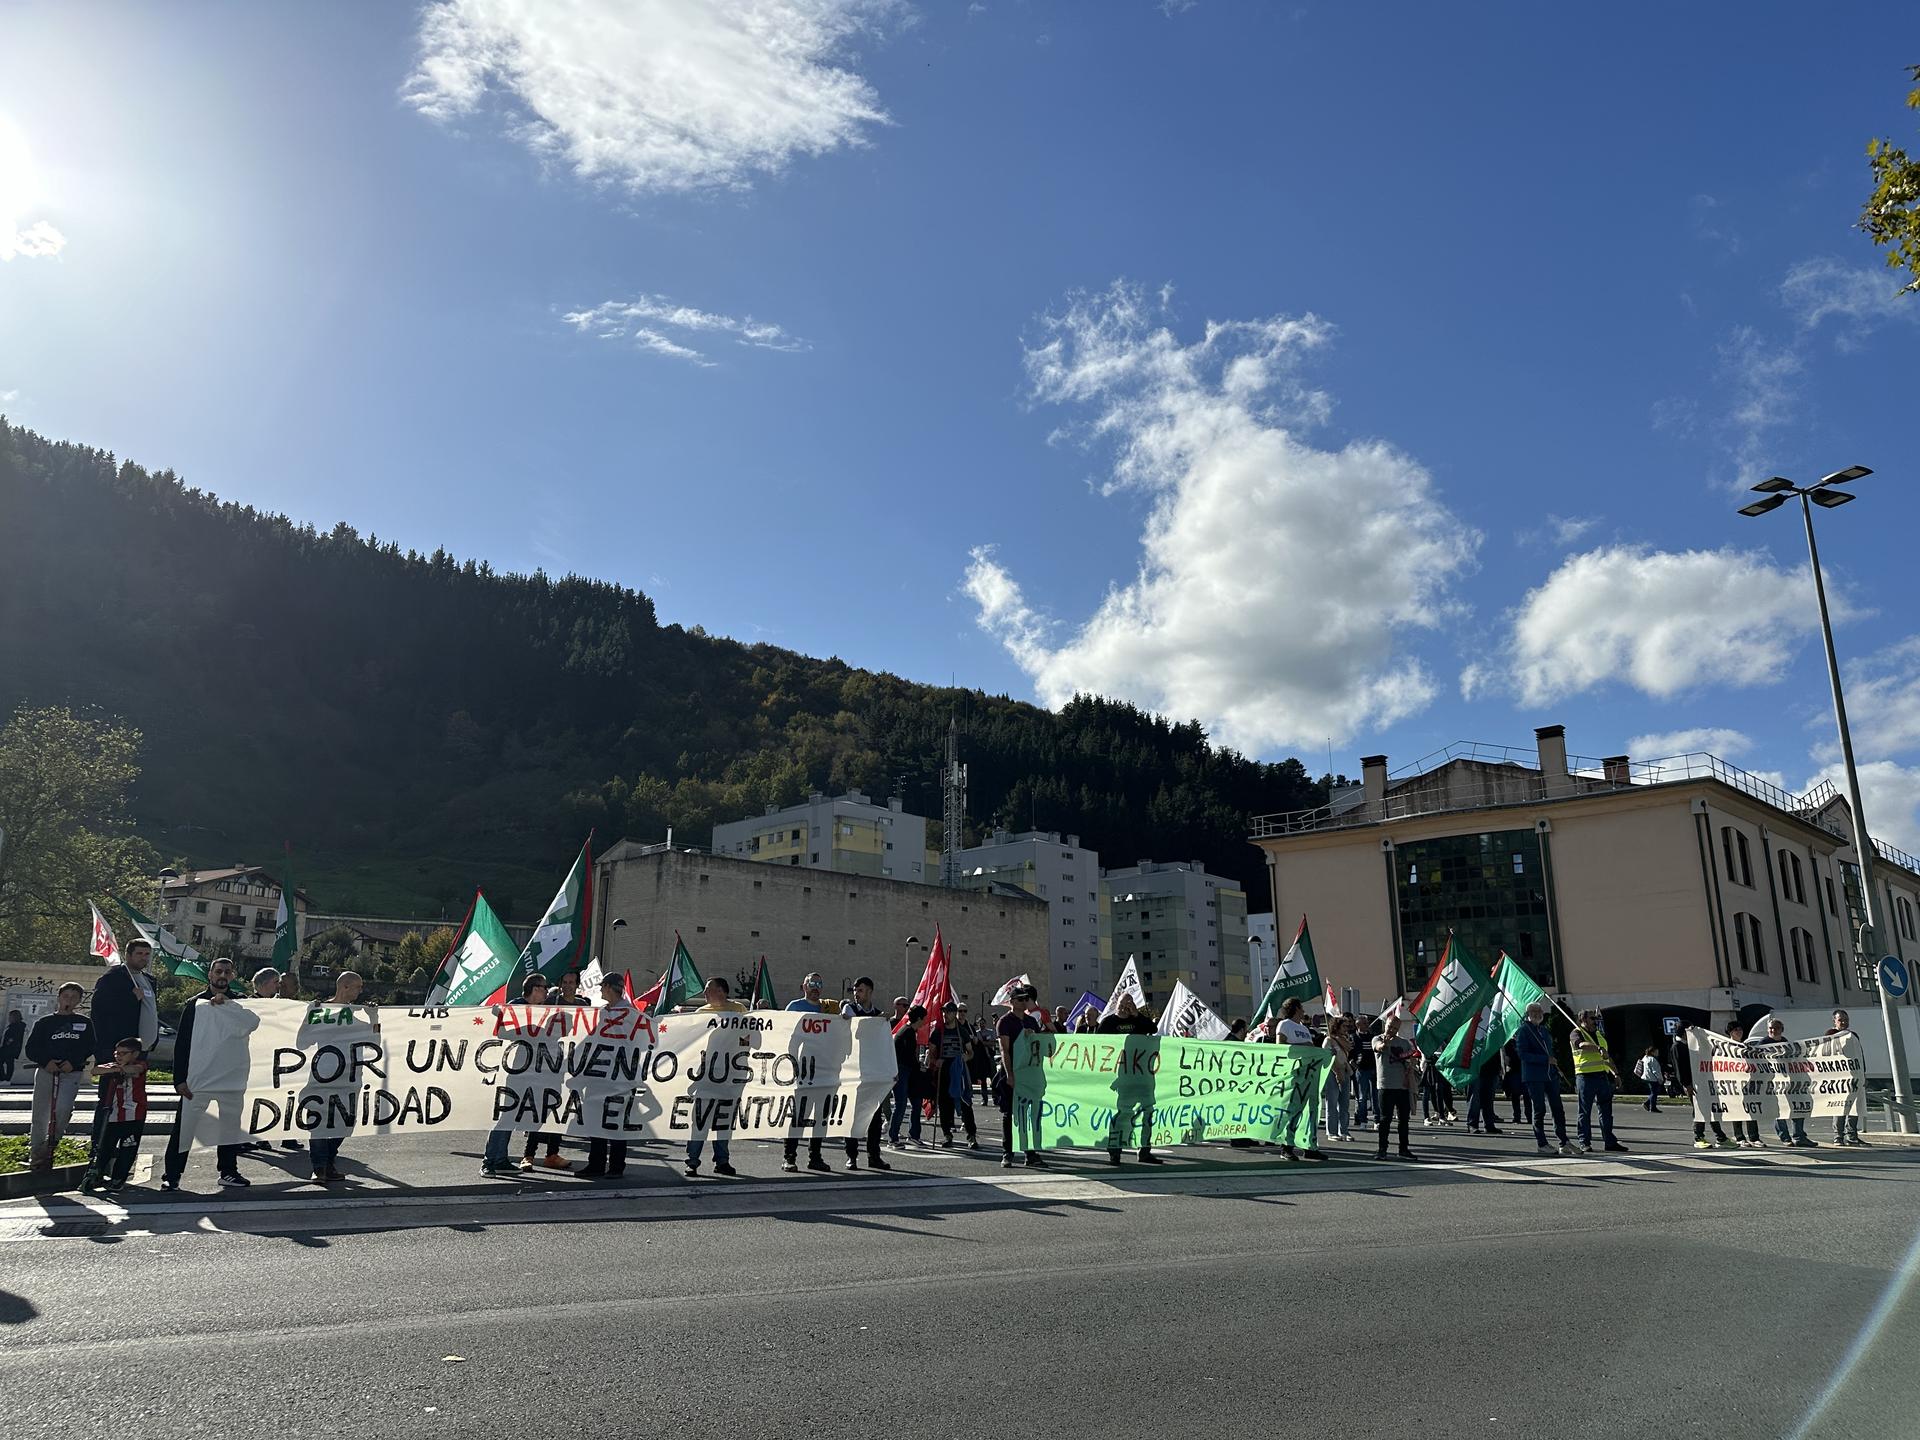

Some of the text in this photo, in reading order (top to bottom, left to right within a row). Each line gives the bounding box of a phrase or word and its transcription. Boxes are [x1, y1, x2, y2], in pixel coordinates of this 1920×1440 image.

[308, 1007, 450, 1025] ELA LAB
[492, 1005, 656, 1043] AVANZA
[706, 1017, 831, 1034] AURRERA UGT
[1665, 1020, 1676, 1033] P
[51, 1031, 80, 1040] adidas
[272, 1041, 387, 1088] POR
[405, 1039, 468, 1073] UN
[1028, 1040, 1324, 1080] AVANZAKO LANGILEAK
[1815, 1058, 1861, 1073] BAKARRA
[1708, 1079, 1740, 1096] BESTE
[1741, 1080, 1764, 1096] BAT
[1819, 1079, 1860, 1095] BAIZIK
[493, 1086, 585, 1126] PARA
[602, 1089, 643, 1132] EL
[1711, 1102, 1729, 1113] ELA
[1743, 1101, 1762, 1114] UGT
[1792, 1101, 1811, 1111] LAB
[1090, 1106, 1121, 1131] UN
[1131, 1103, 1225, 1130] CONVENIO
[1206, 1123, 1247, 1138] AURRERA
